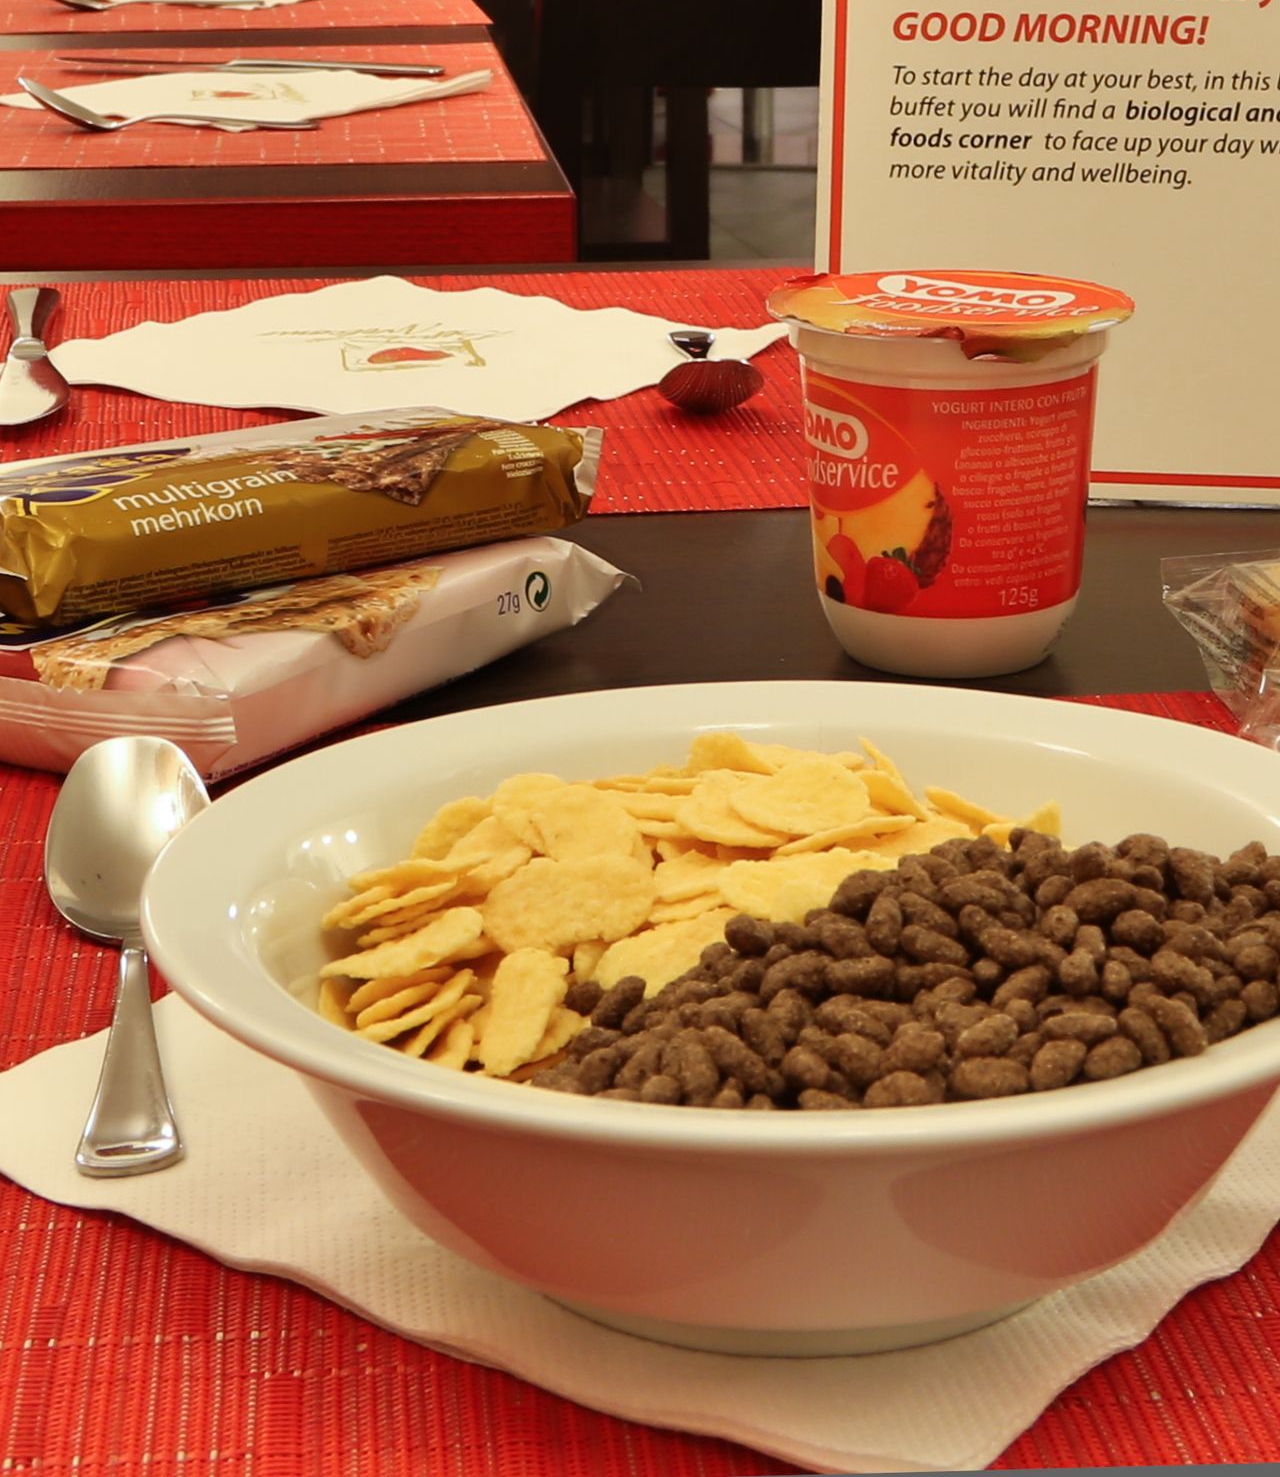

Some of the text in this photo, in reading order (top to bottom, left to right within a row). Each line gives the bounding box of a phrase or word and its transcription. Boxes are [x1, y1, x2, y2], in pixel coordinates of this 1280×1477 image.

[893, 12, 1210, 45] GOOD MORNING!
[895, 65, 916, 85] To
[921, 68, 973, 86] start
[979, 66, 1013, 87] the
[1018, 67, 1059, 93] day
[1064, 71, 1088, 88] at
[1093, 74, 1143, 93] your
[1147, 69, 1197, 92] best,
[1204, 70, 1224, 90] in
[1232, 70, 1271, 91] this
[890, 95, 956, 117] buffet
[962, 103, 1001, 122] you
[1008, 98, 1047, 118] will
[1053, 98, 1097, 119] find
[1102, 105, 1116, 119] a
[1126, 100, 1241, 126] biological
[890, 127, 953, 148] foods
[958, 134, 1033, 149] corner
[1045, 133, 1066, 150] to
[1072, 130, 1118, 151] face
[1124, 137, 1152, 157] up
[1158, 138, 1209, 158] your
[1213, 133, 1255, 159] day
[889, 160, 1192, 190] more vitality and wellbeing.
[828, 293, 1102, 317] foodservice
[902, 277, 1058, 307] YOMO
[931, 401, 985, 414] YOGURT
[989, 397, 1034, 412] INTERO
[1037, 395, 1059, 409] CON
[805, 409, 858, 451] OMO
[112, 467, 298, 512] multigrain
[130, 494, 264, 538] mehrkorn
[497, 591, 520, 615] 27g
[998, 586, 1039, 607] 125g
